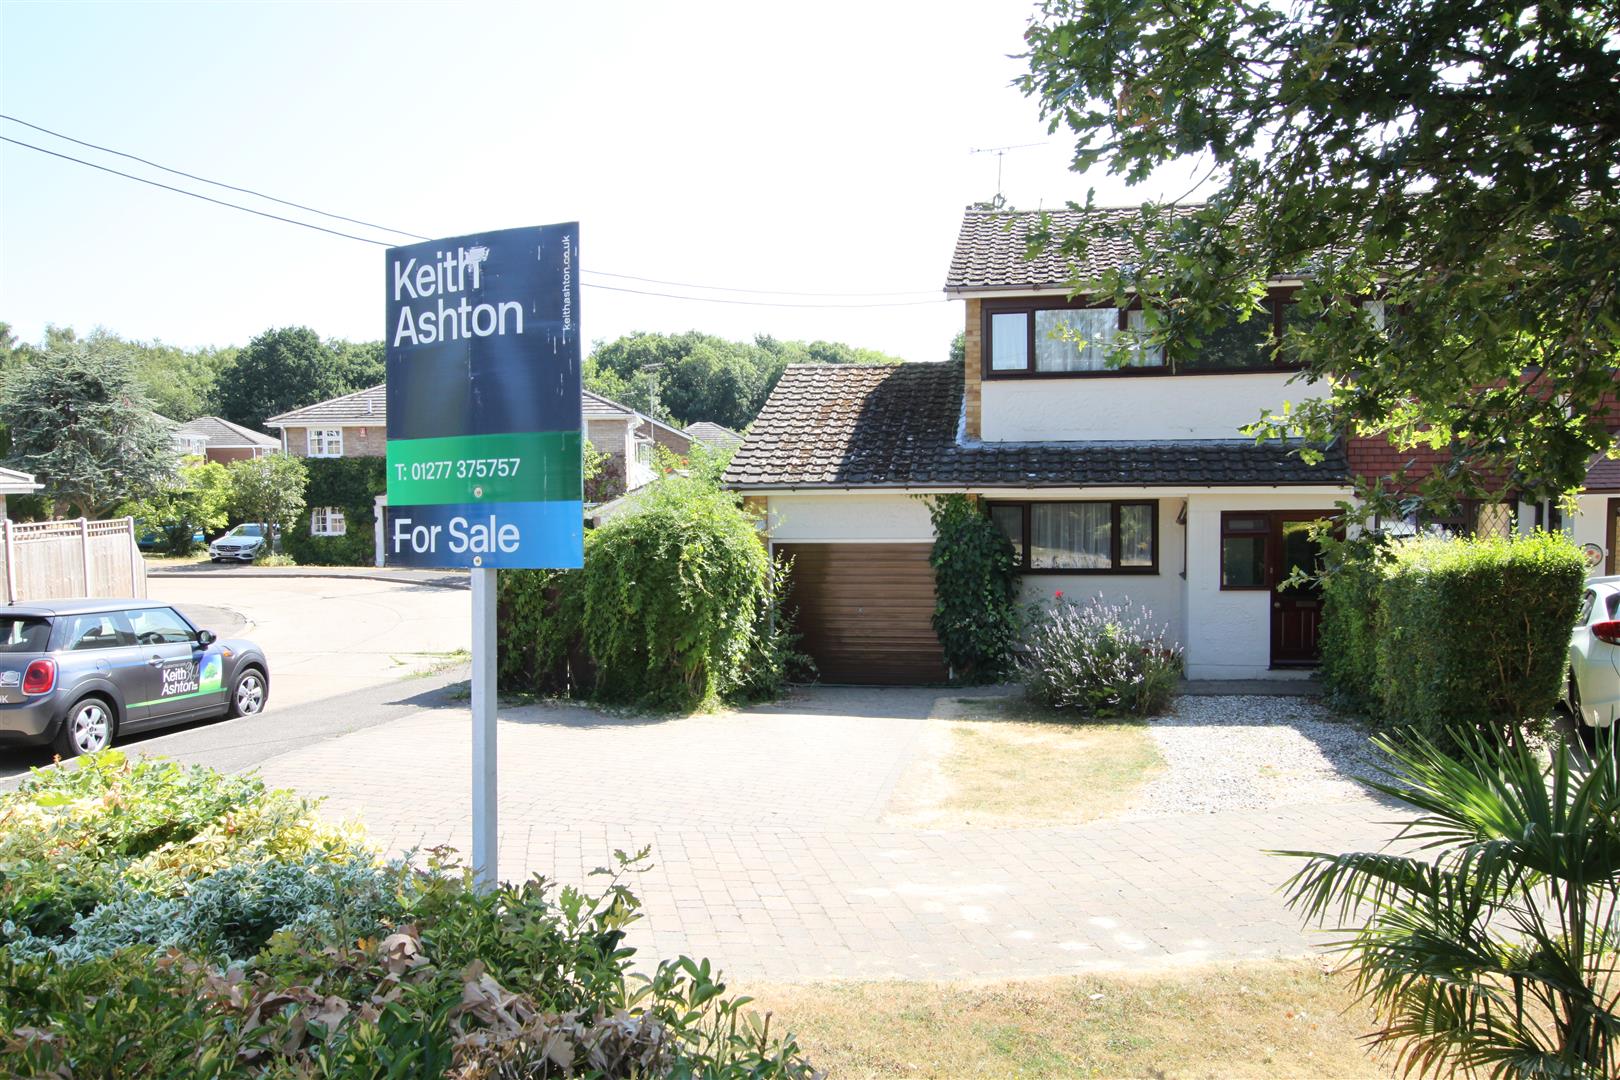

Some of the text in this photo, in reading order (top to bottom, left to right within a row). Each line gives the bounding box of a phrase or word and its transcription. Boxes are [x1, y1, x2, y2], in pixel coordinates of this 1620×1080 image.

[395, 247, 480, 301] Keith
[561, 234, 571, 331] keithashton.co.uk
[393, 297, 523, 347] Ashton
[395, 458, 521, 481] T: 01277 375757
[394, 514, 521, 553] For Sale
[161, 681, 194, 696] Ashton
[163, 667, 187, 683] Keith
